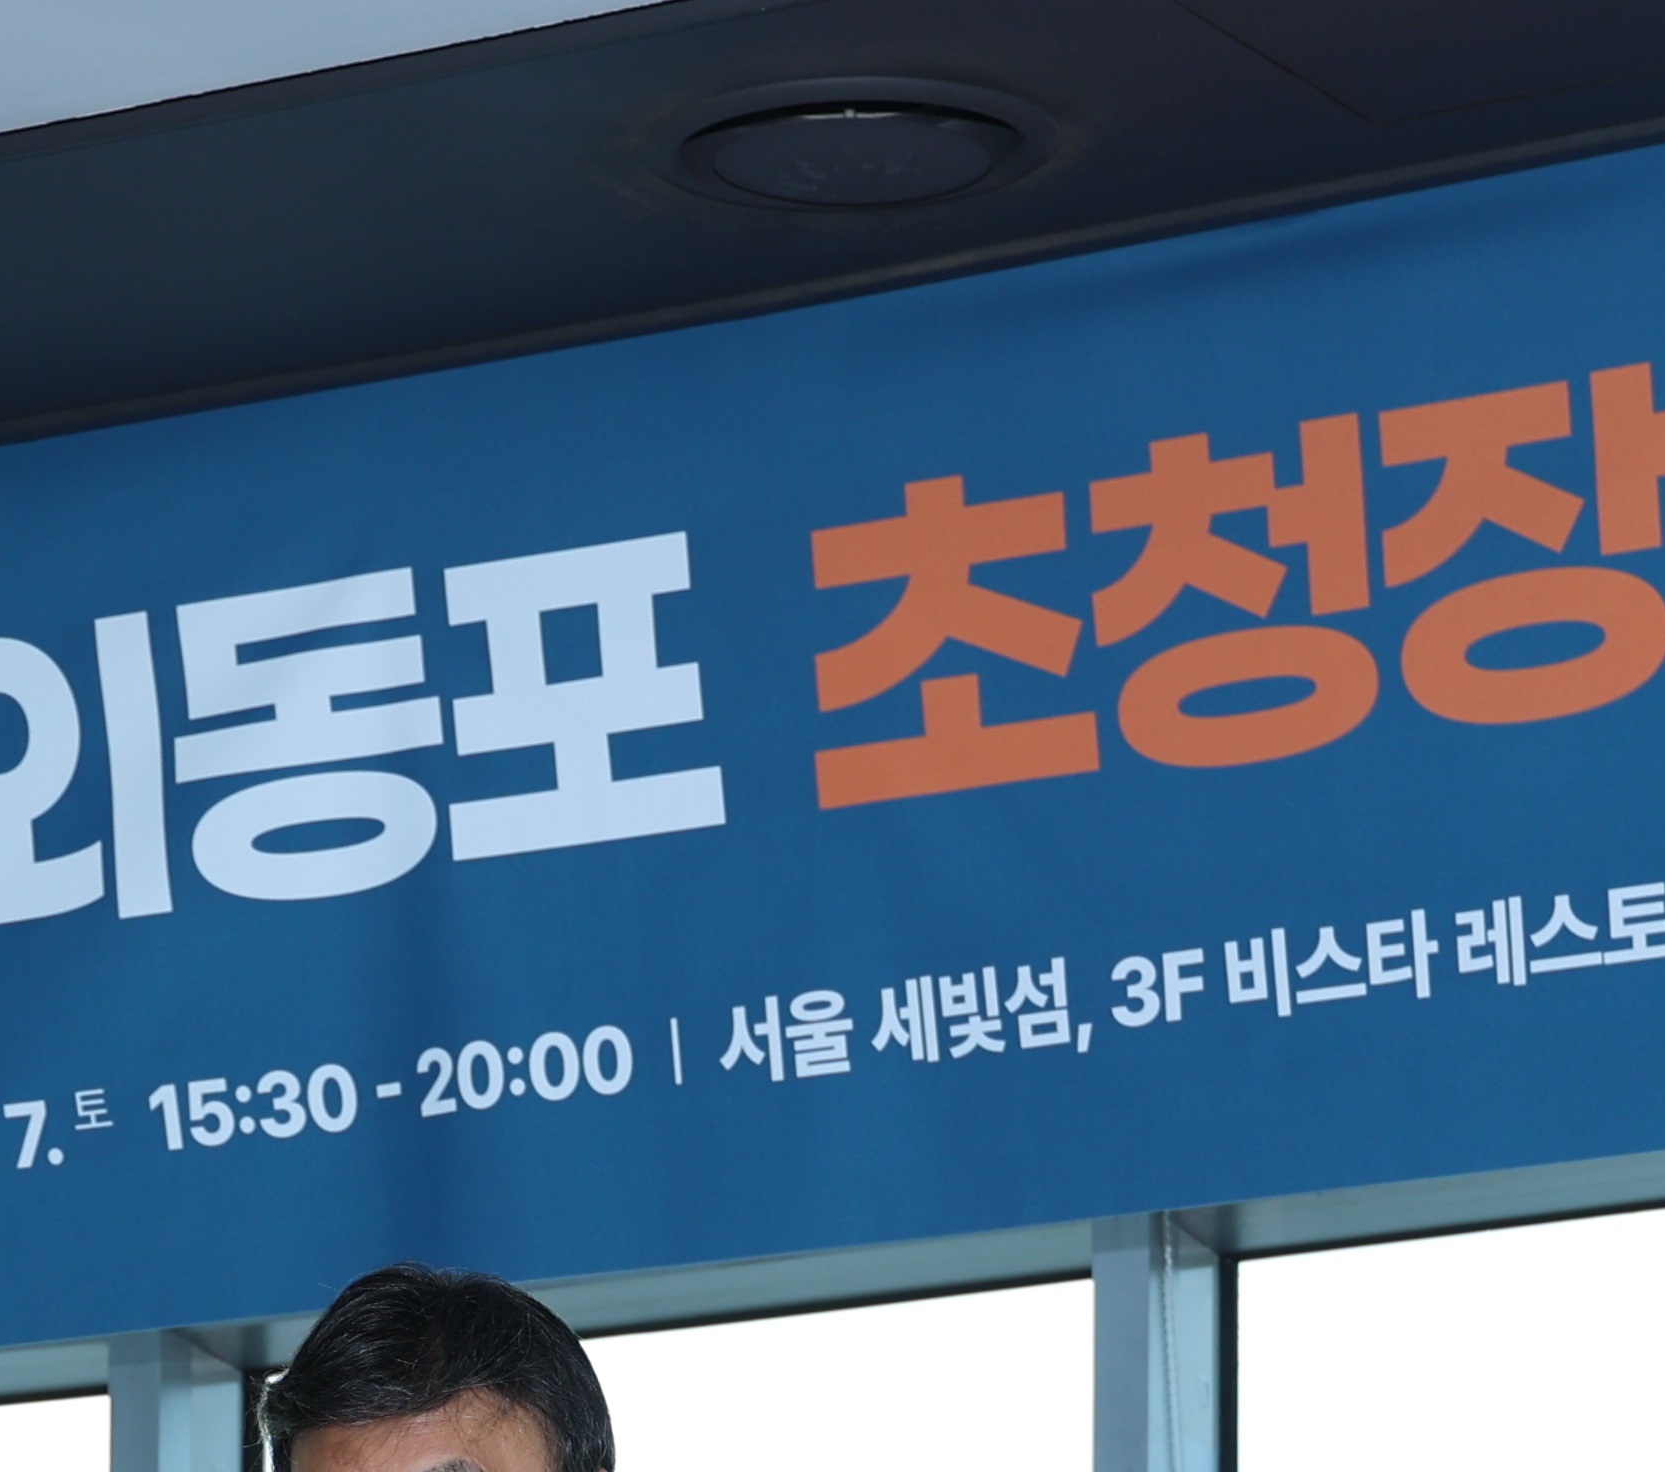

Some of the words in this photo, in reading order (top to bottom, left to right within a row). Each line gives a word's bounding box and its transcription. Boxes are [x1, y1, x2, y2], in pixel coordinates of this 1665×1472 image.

[75, 1088, 113, 1130] 토
[149, 1064, 357, 1151] 15:30
[417, 1025, 633, 1117] 20:00
[719, 990, 854, 1082] 서울
[871, 956, 1092, 1063] 세빛섬,
[1111, 948, 1204, 1027] 3F
[1224, 908, 1439, 1017] 비스타
